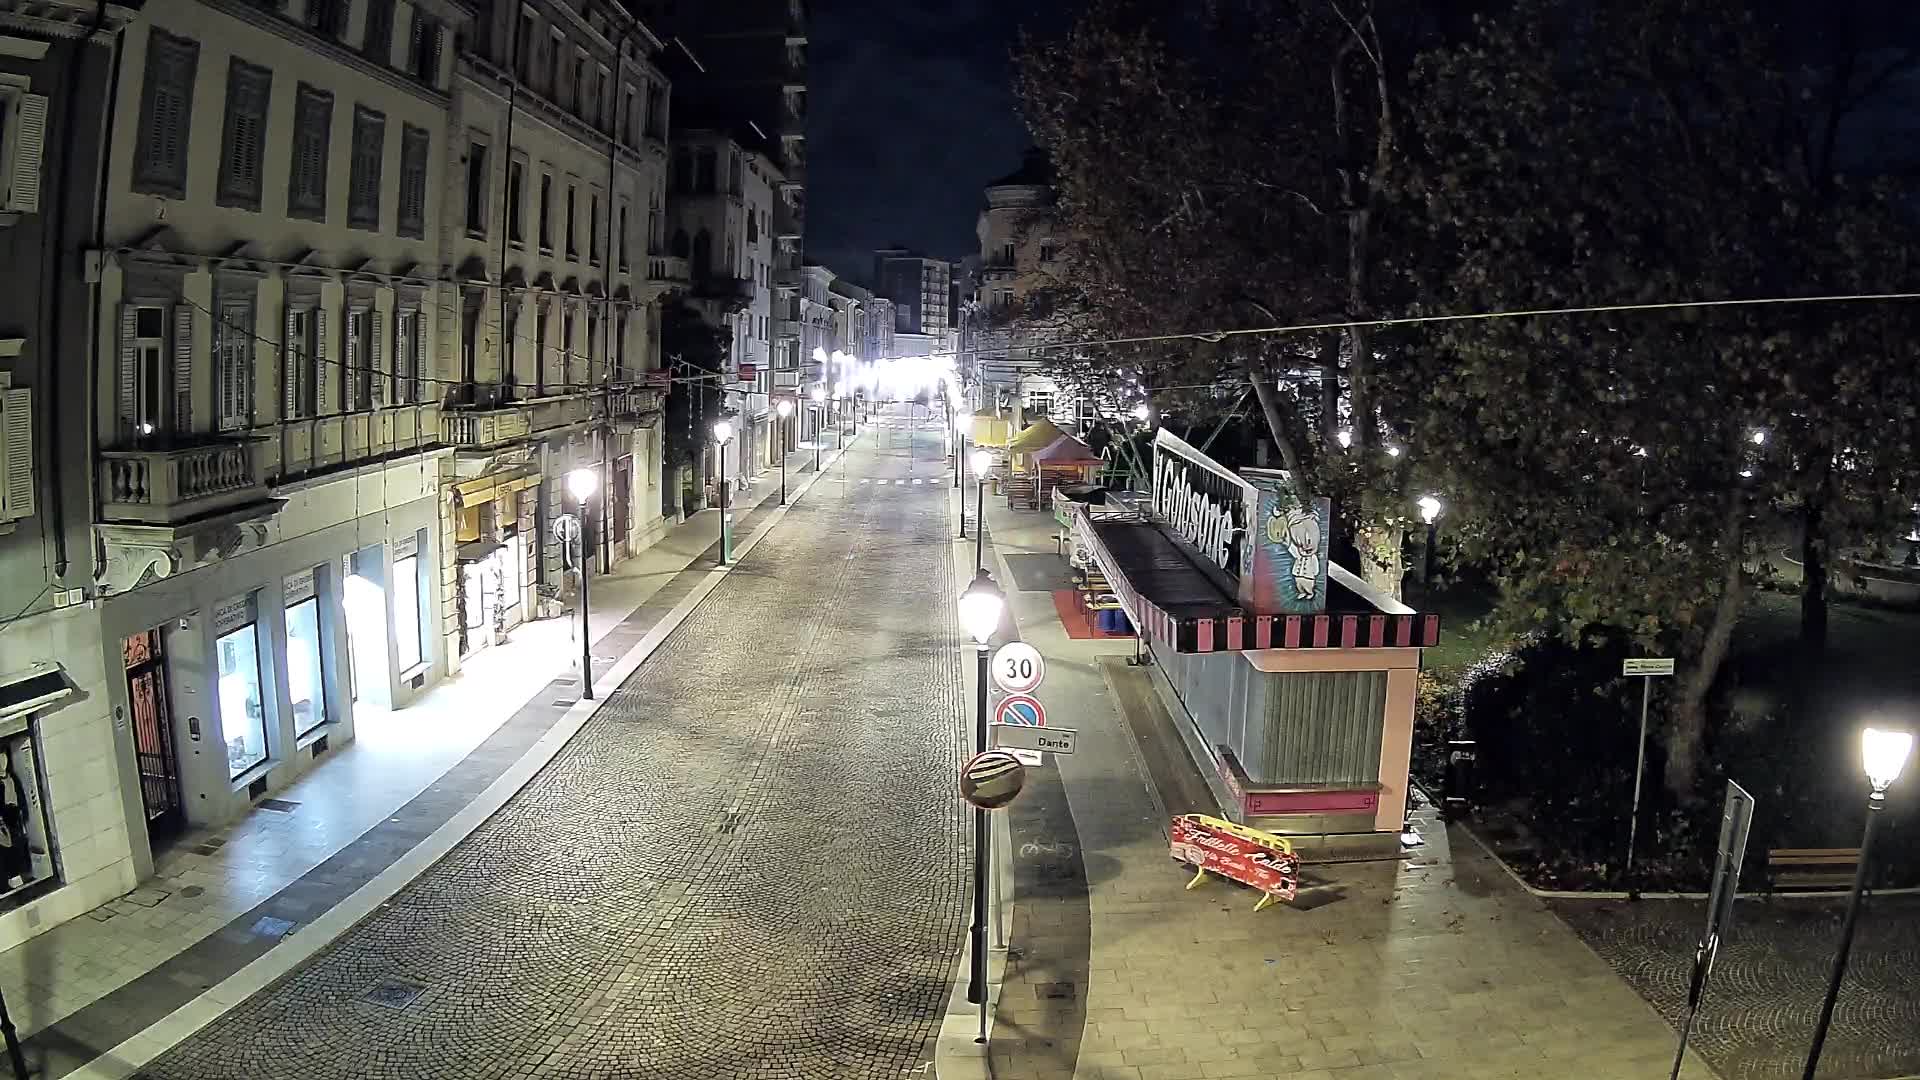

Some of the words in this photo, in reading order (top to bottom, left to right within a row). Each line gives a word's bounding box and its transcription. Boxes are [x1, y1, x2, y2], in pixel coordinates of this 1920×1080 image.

[1162, 458, 1233, 569] Golosone
[1006, 658, 1032, 679] 30
[1038, 737, 1069, 749] Dante
